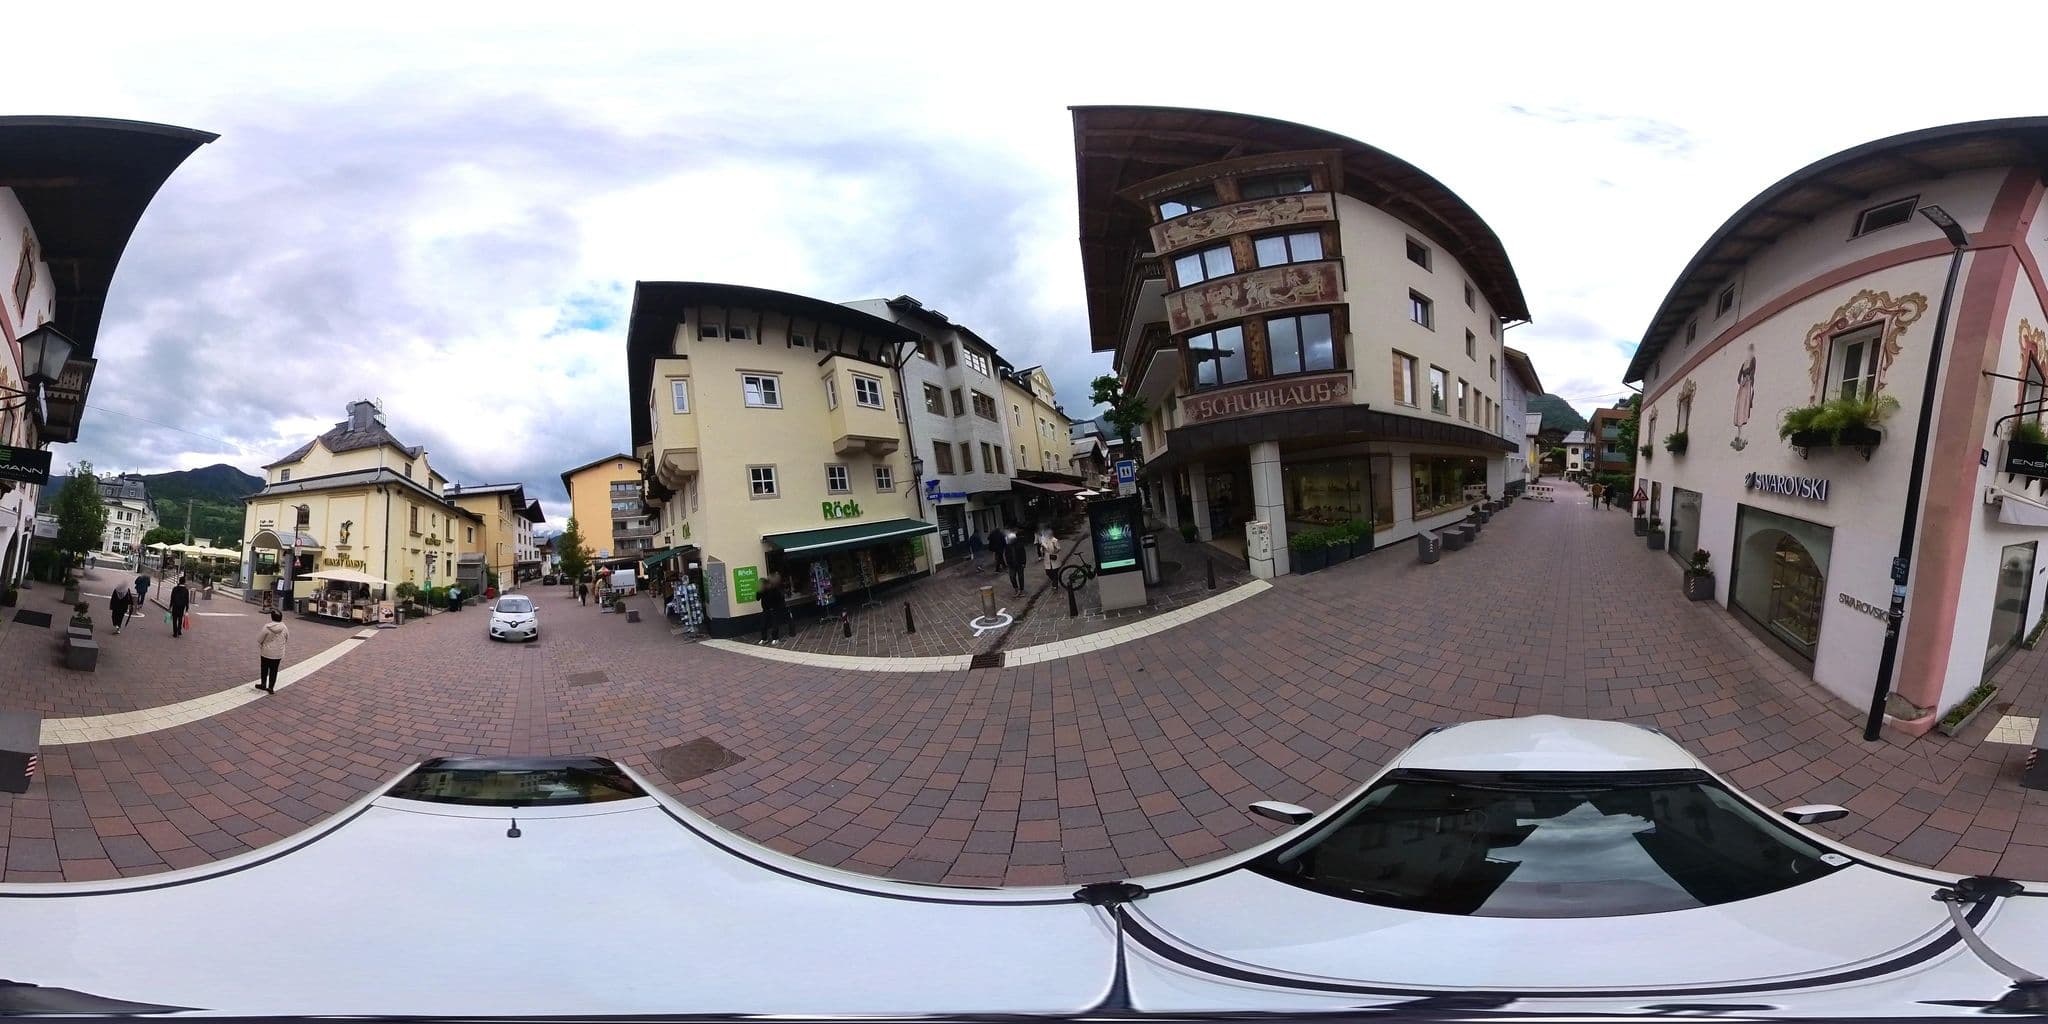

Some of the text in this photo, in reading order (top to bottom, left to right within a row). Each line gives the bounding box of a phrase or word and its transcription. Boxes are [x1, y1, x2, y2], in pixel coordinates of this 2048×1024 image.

[1200, 382, 1331, 418] SCHUHHAUS
[2012, 458, 2048, 469] ENS
[1755, 474, 1828, 501] SWAROVSKI
